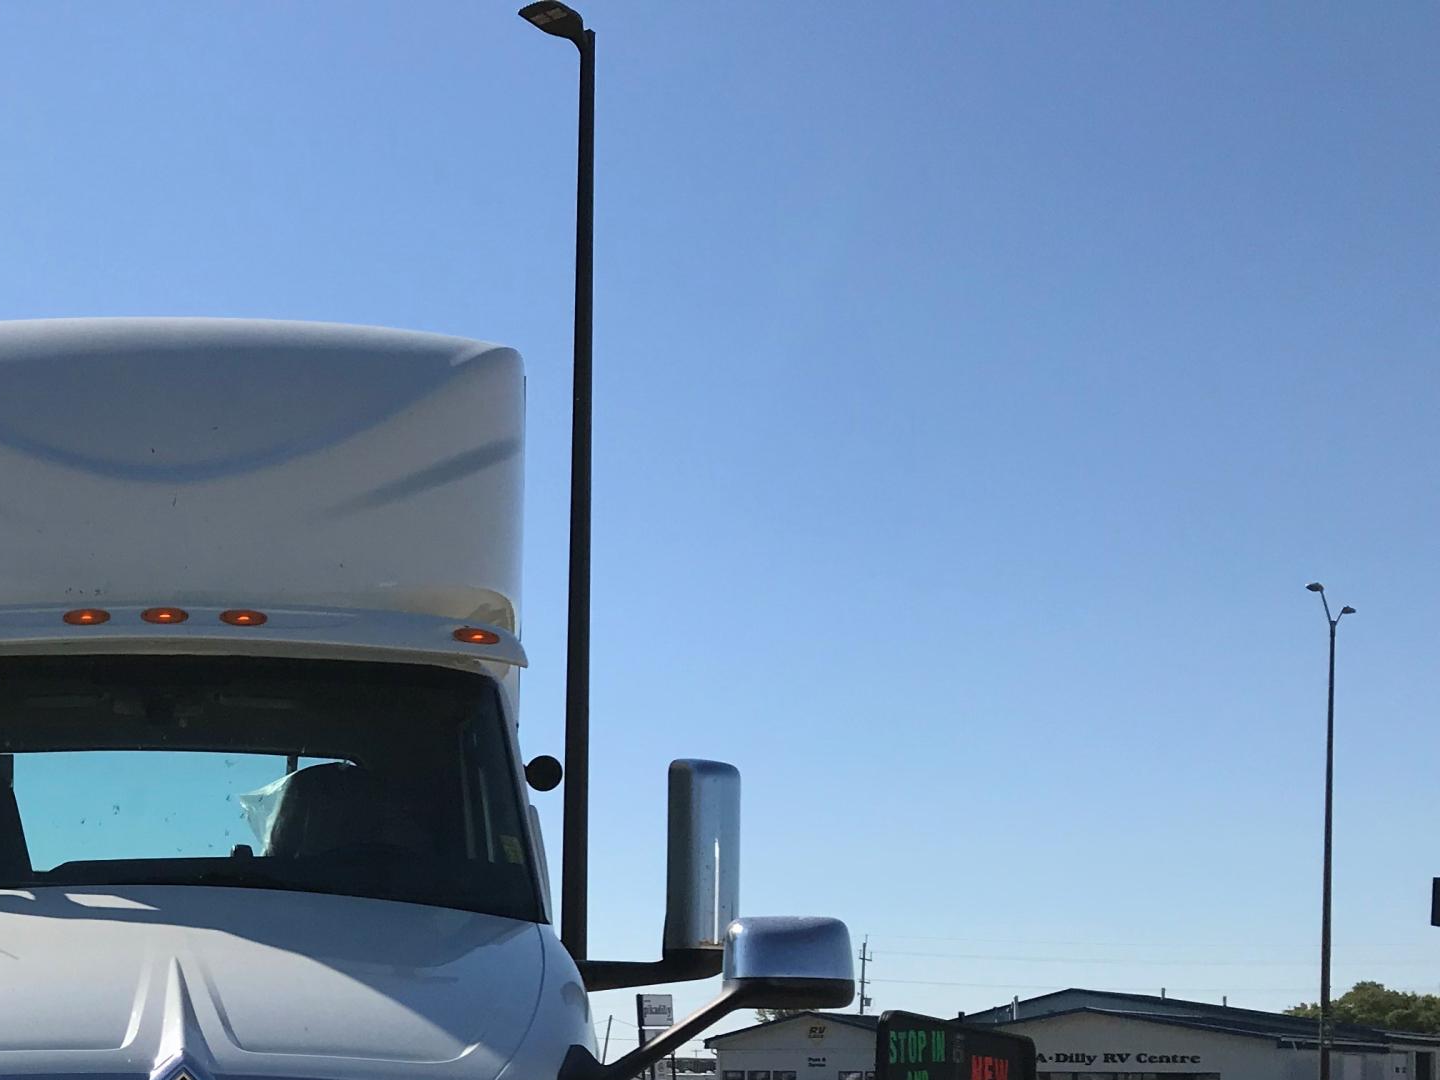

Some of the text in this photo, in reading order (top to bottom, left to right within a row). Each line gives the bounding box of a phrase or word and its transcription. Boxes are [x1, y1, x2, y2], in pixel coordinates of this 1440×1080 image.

[888, 1029, 946, 1064] STOP IN
[1103, 1052, 1131, 1064] RV
[1136, 1052, 1202, 1064] Centre
